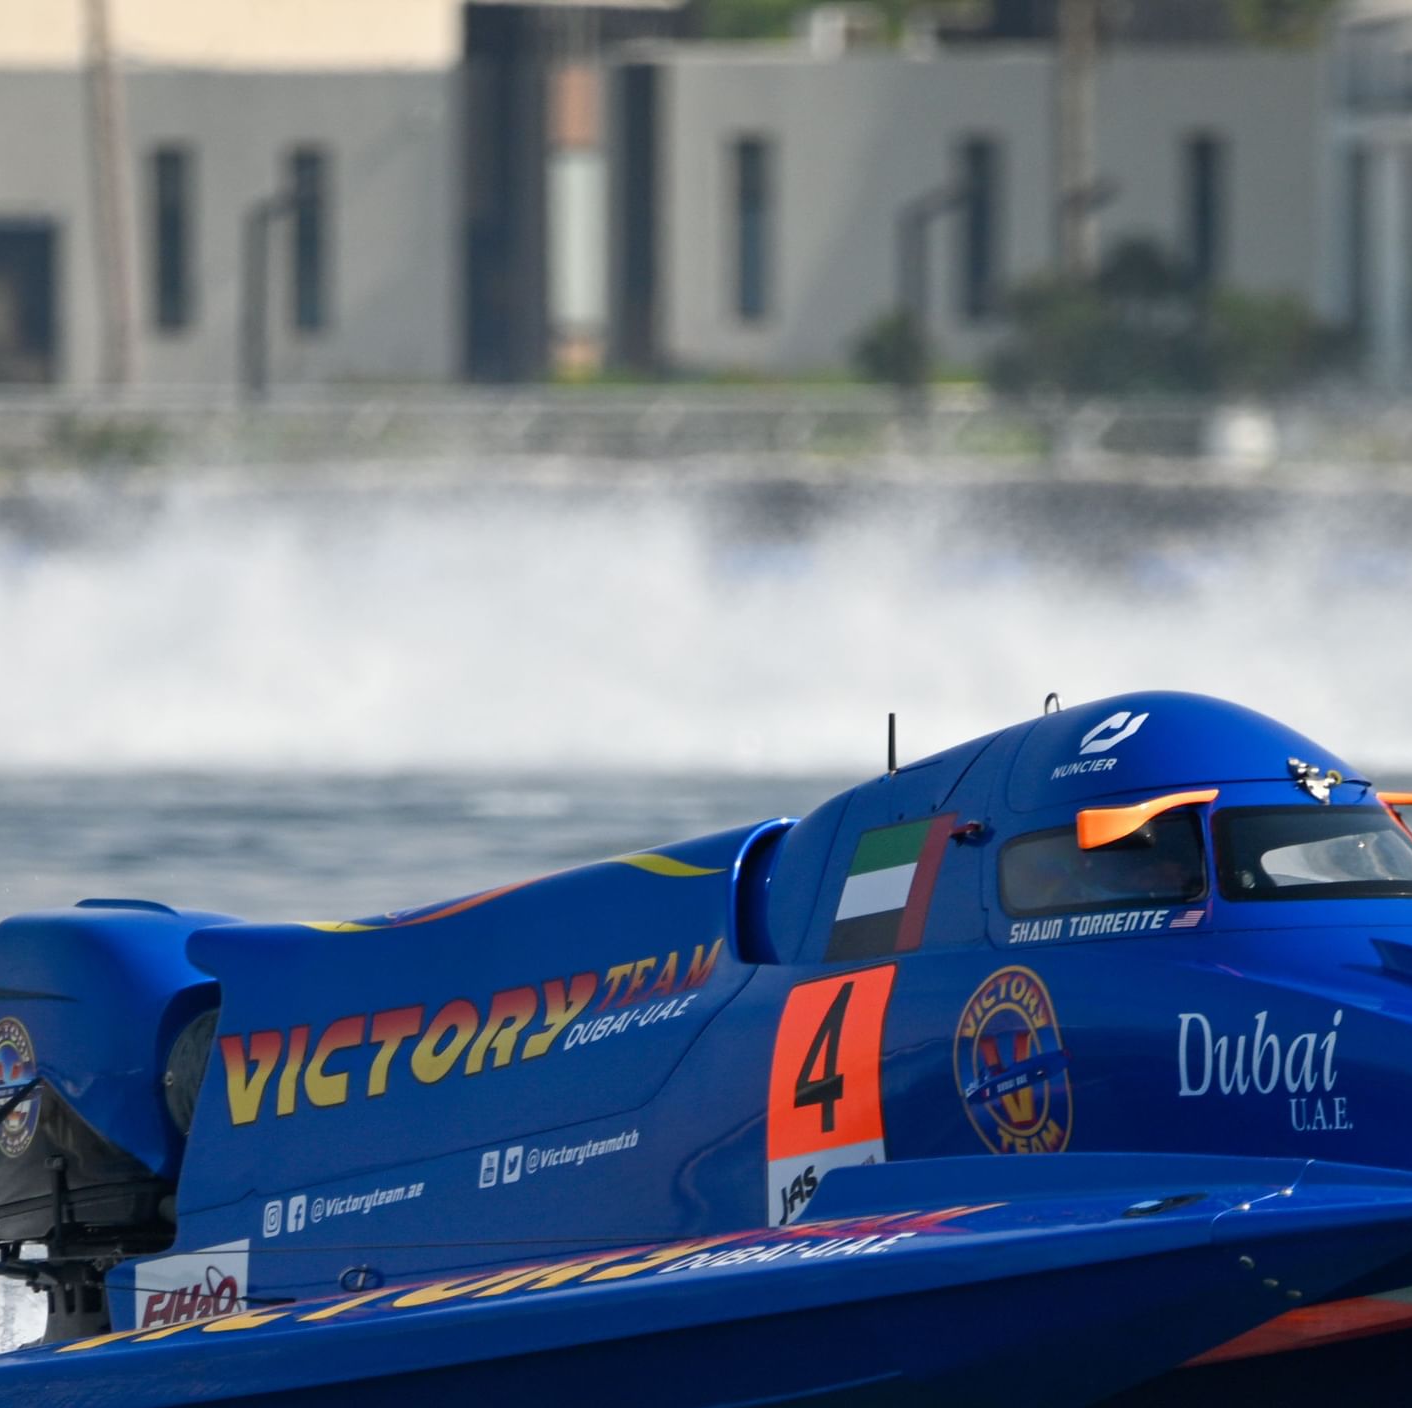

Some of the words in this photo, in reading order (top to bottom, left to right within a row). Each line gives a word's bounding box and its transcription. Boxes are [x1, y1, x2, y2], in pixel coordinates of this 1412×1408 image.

[1051, 758, 1117, 780] NUNCIER
[1009, 918, 1062, 944] SHAUN
[1069, 910, 1169, 937] TORRENTE
[959, 974, 1050, 1037] VICTORY
[219, 971, 599, 1127] VICTORY
[592, 938, 724, 1012] TEAM
[794, 981, 855, 1133] 4
[1178, 1009, 1343, 1097] Dubai
[1289, 1097, 1353, 1131] U.A.E.
[310, 1182, 425, 1223] @Victoryteam.ae
